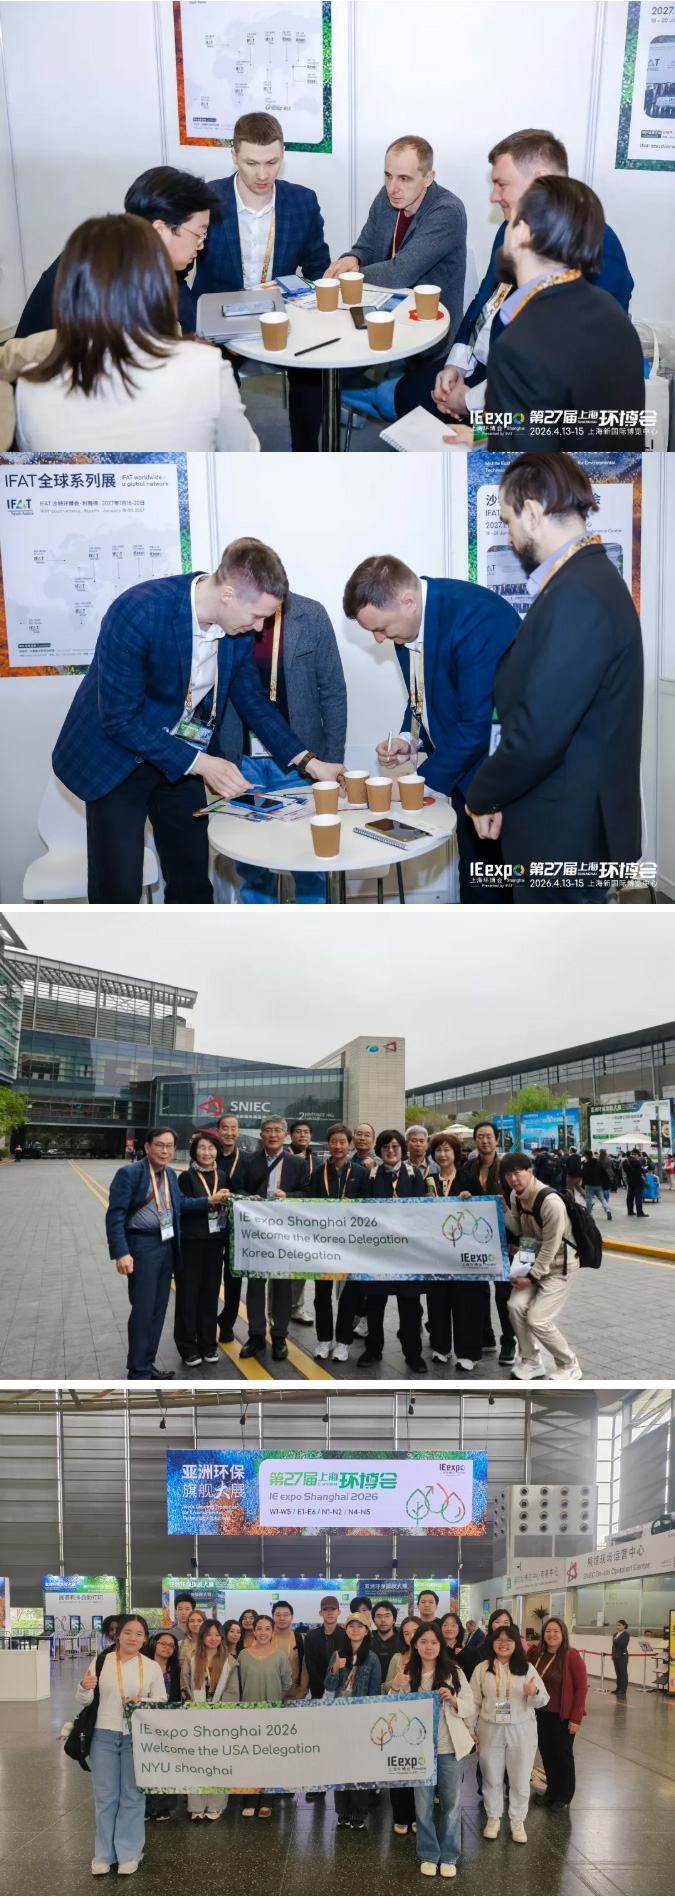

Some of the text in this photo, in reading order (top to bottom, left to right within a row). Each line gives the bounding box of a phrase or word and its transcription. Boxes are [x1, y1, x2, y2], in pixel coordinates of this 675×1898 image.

[230, 1101, 270, 1112] SNIEC
[239, 1212, 378, 1229] IE expo Shanghai 2026
[241, 1230, 408, 1246] Welcome the Korea Delegation
[242, 1248, 341, 1261] Korea Delegation
[182, 1464, 244, 1479] 亚洲环保
[182, 1481, 244, 1500] 旗舰大展
[304, 1493, 349, 1502] Shanghai
[350, 1493, 378, 1501] 2026
[140, 1723, 297, 1740] IE expo Shanghai 2026
[140, 1742, 320, 1757] Welcome the USA Delegation
[141, 1762, 233, 1776] NYU shanghai
